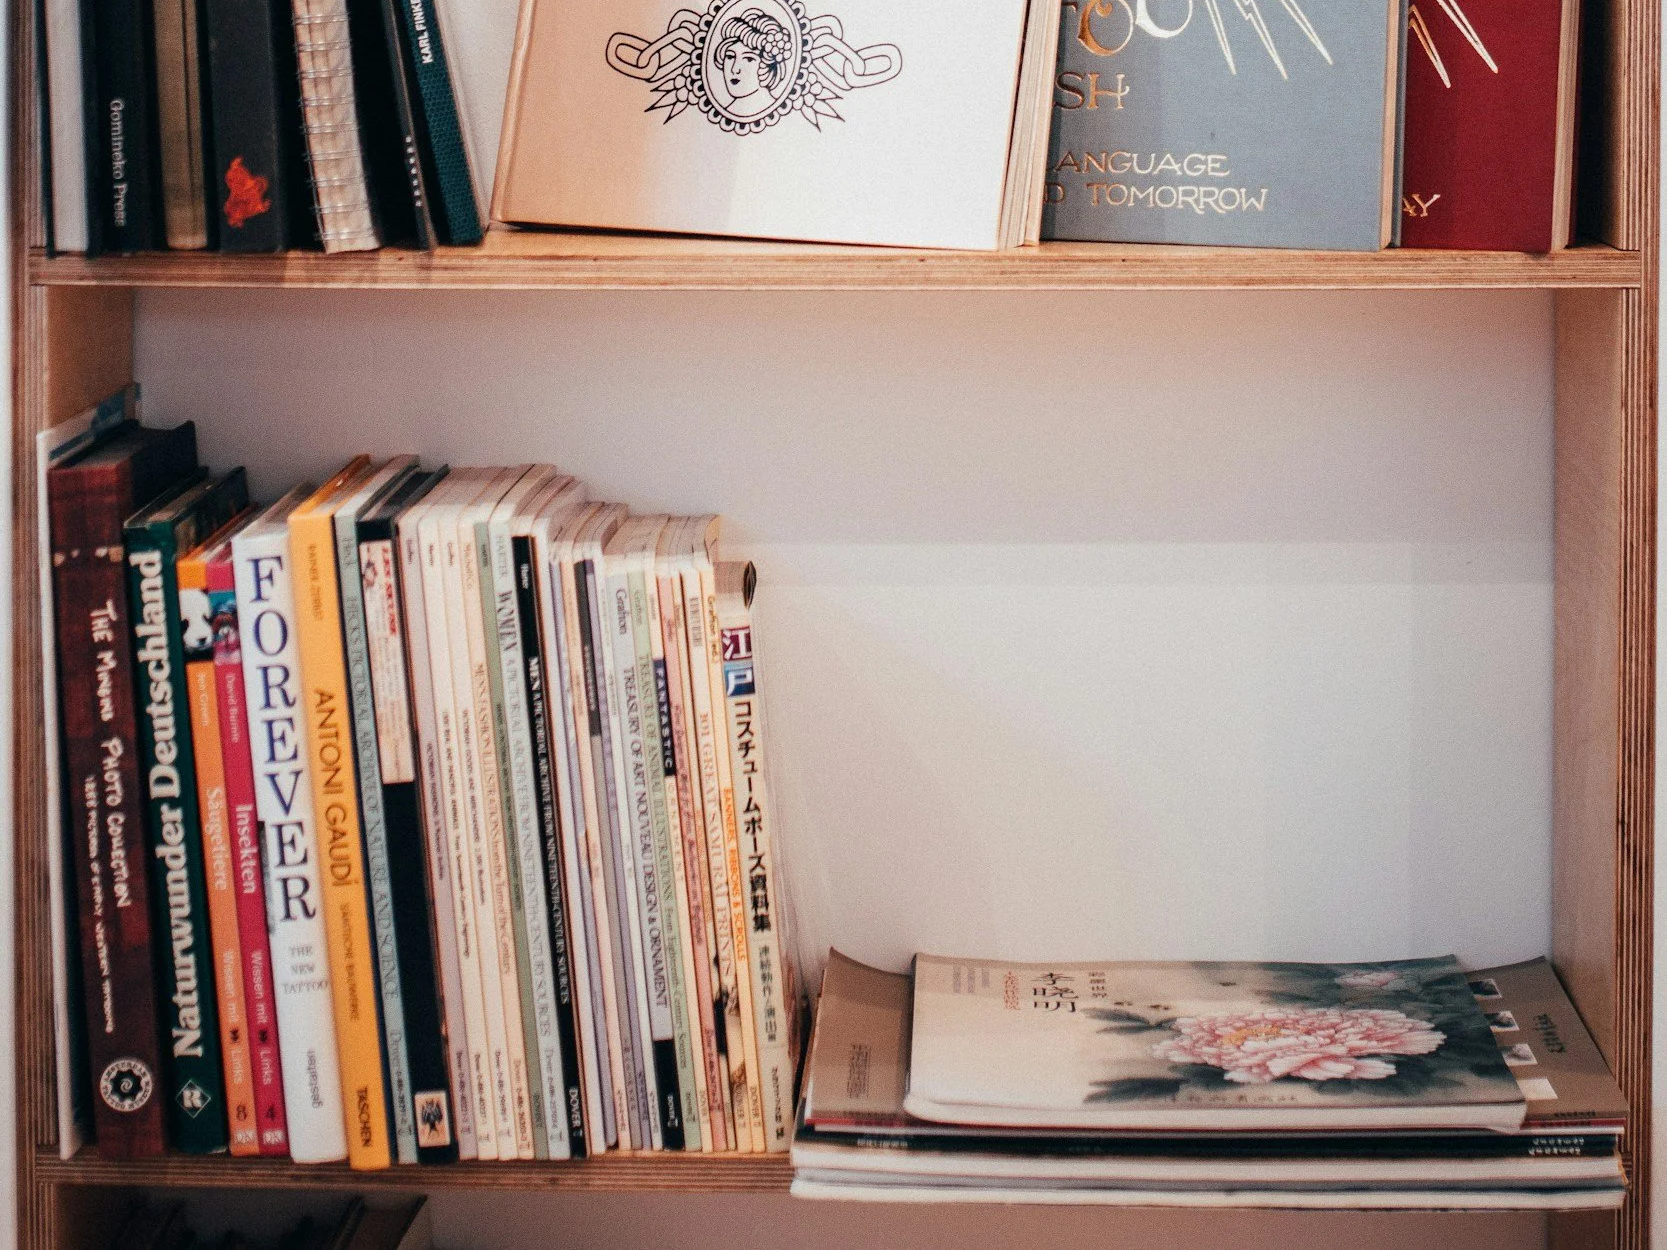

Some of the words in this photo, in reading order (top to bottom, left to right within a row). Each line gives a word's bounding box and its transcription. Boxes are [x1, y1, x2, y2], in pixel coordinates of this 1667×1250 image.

[417, 29, 434, 64] KARL
[1049, 150, 1231, 178] ANGUAGE
[113, 183, 128, 227] Press
[1086, 181, 1269, 215] TOMORROW
[90, 600, 118, 643] THE
[495, 590, 519, 652] WOMEN
[614, 587, 632, 635] Grafton
[129, 550, 181, 799] Deutschland
[621, 665, 640, 735] TREASURY
[654, 667, 674, 769] FANTASTIC
[248, 555, 317, 922] FOREVER
[314, 690, 343, 795] ANTONI
[629, 739, 642, 759] OF
[101, 737, 124, 807] PHOTO
[632, 762, 645, 788] ART
[204, 787, 229, 890] Säugetiere
[235, 805, 257, 893] Insekten
[635, 791, 653, 861] NOUVEAU
[107, 812, 131, 907] COLLECTION
[642, 863, 658, 913] DESIGN
[157, 803, 203, 1058] Naturwunder
[289, 945, 313, 956] THE
[252, 952, 265, 998] Wissen
[282, 980, 329, 994] TATTOO
[290, 963, 315, 975] NEW
[648, 927, 667, 1009] ORNAMENT
[257, 1004, 268, 1023] mit
[260, 1049, 273, 1085] Links
[357, 1086, 372, 1148] TASCHEN
[568, 1088, 581, 1127] DOVER
